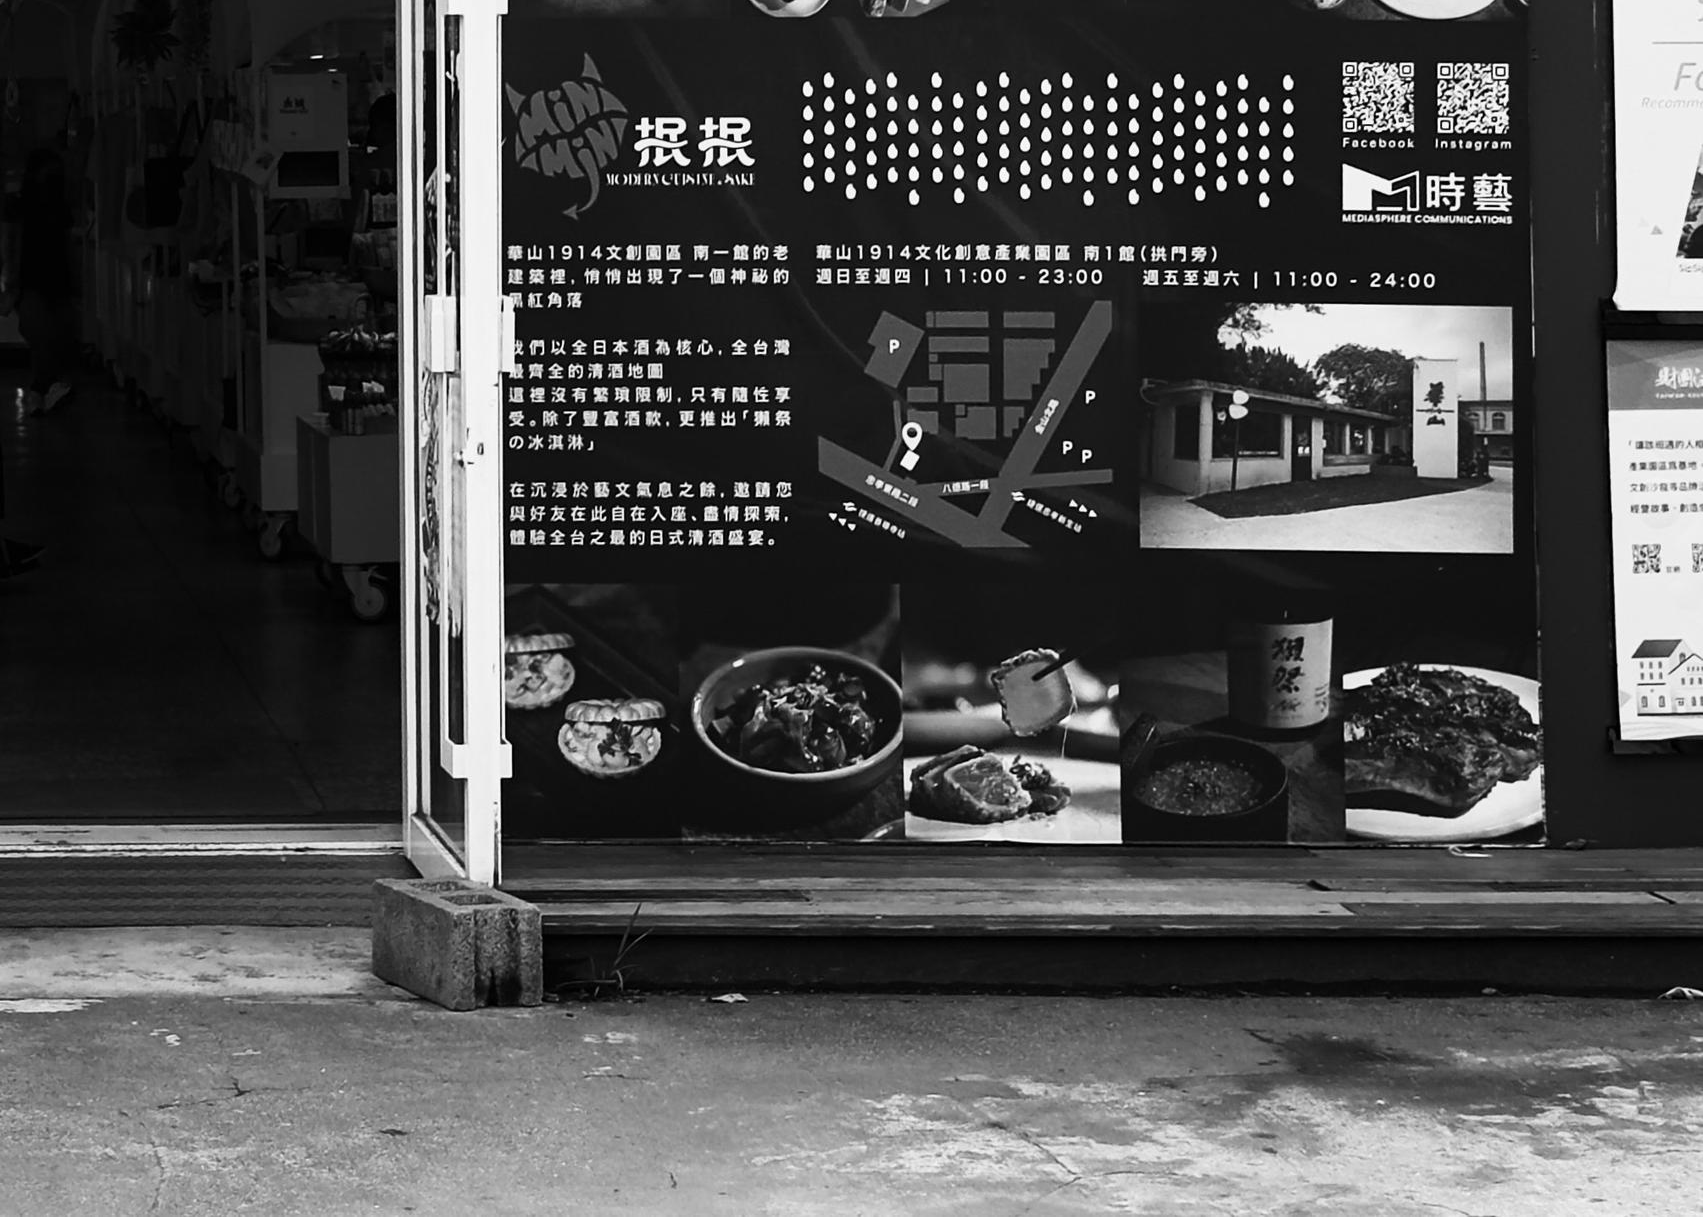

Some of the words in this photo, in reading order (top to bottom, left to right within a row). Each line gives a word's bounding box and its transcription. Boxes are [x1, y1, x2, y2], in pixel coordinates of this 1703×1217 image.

[1343, 138, 1414, 148] Facebook
[1436, 139, 1511, 151] Instagram
[1427, 172, 1512, 212] 時藝
[1343, 214, 1411, 223] MEDIASPHERE
[1415, 215, 1512, 224] COMMUNICATIONS
[508, 245, 680, 260] 華山1914文創園區
[694, 245, 788, 260] 南一館的老
[817, 244, 1070, 261] 華山1914文化創意產業園區
[816, 268, 910, 284] 週日至週四
[945, 269, 1006, 283] 11:00
[1039, 269, 1102, 284] 23:00
[1143, 270, 1239, 286] 週五至週六
[1275, 272, 1337, 286] 11:00
[1370, 273, 1435, 288] 24:00
